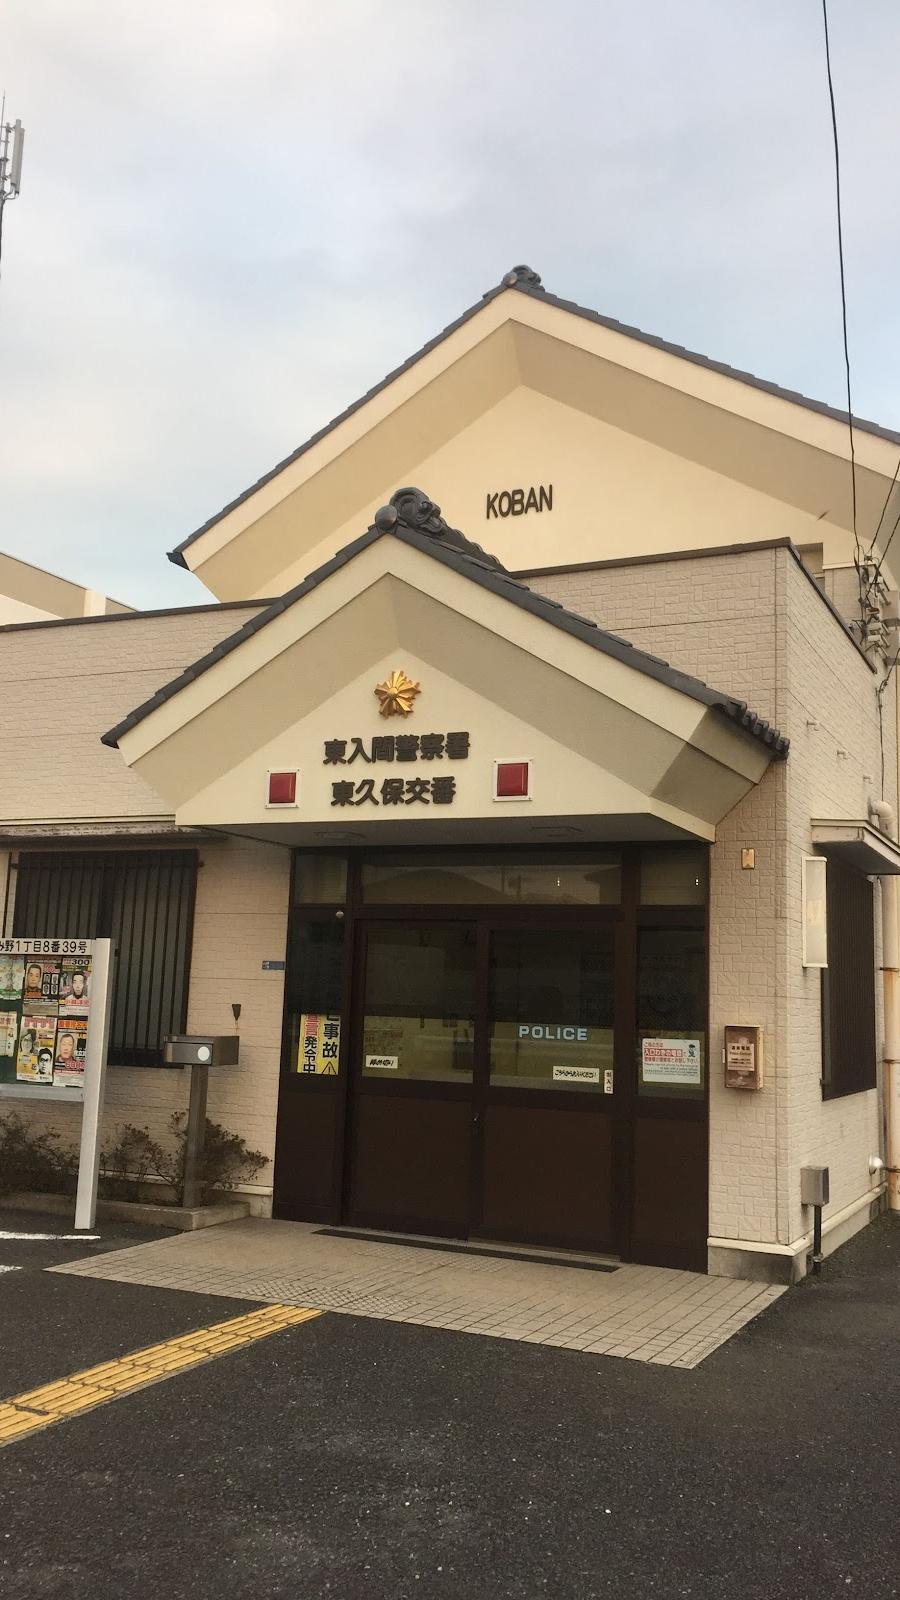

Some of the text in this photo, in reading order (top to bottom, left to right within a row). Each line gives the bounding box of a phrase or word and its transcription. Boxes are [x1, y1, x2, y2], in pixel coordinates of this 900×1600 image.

[486, 484, 553, 520] KOBAN
[323, 731, 471, 765] 東入間警察署
[330, 776, 457, 807] 東久保交番
[519, 1025, 588, 1041] POLICE
